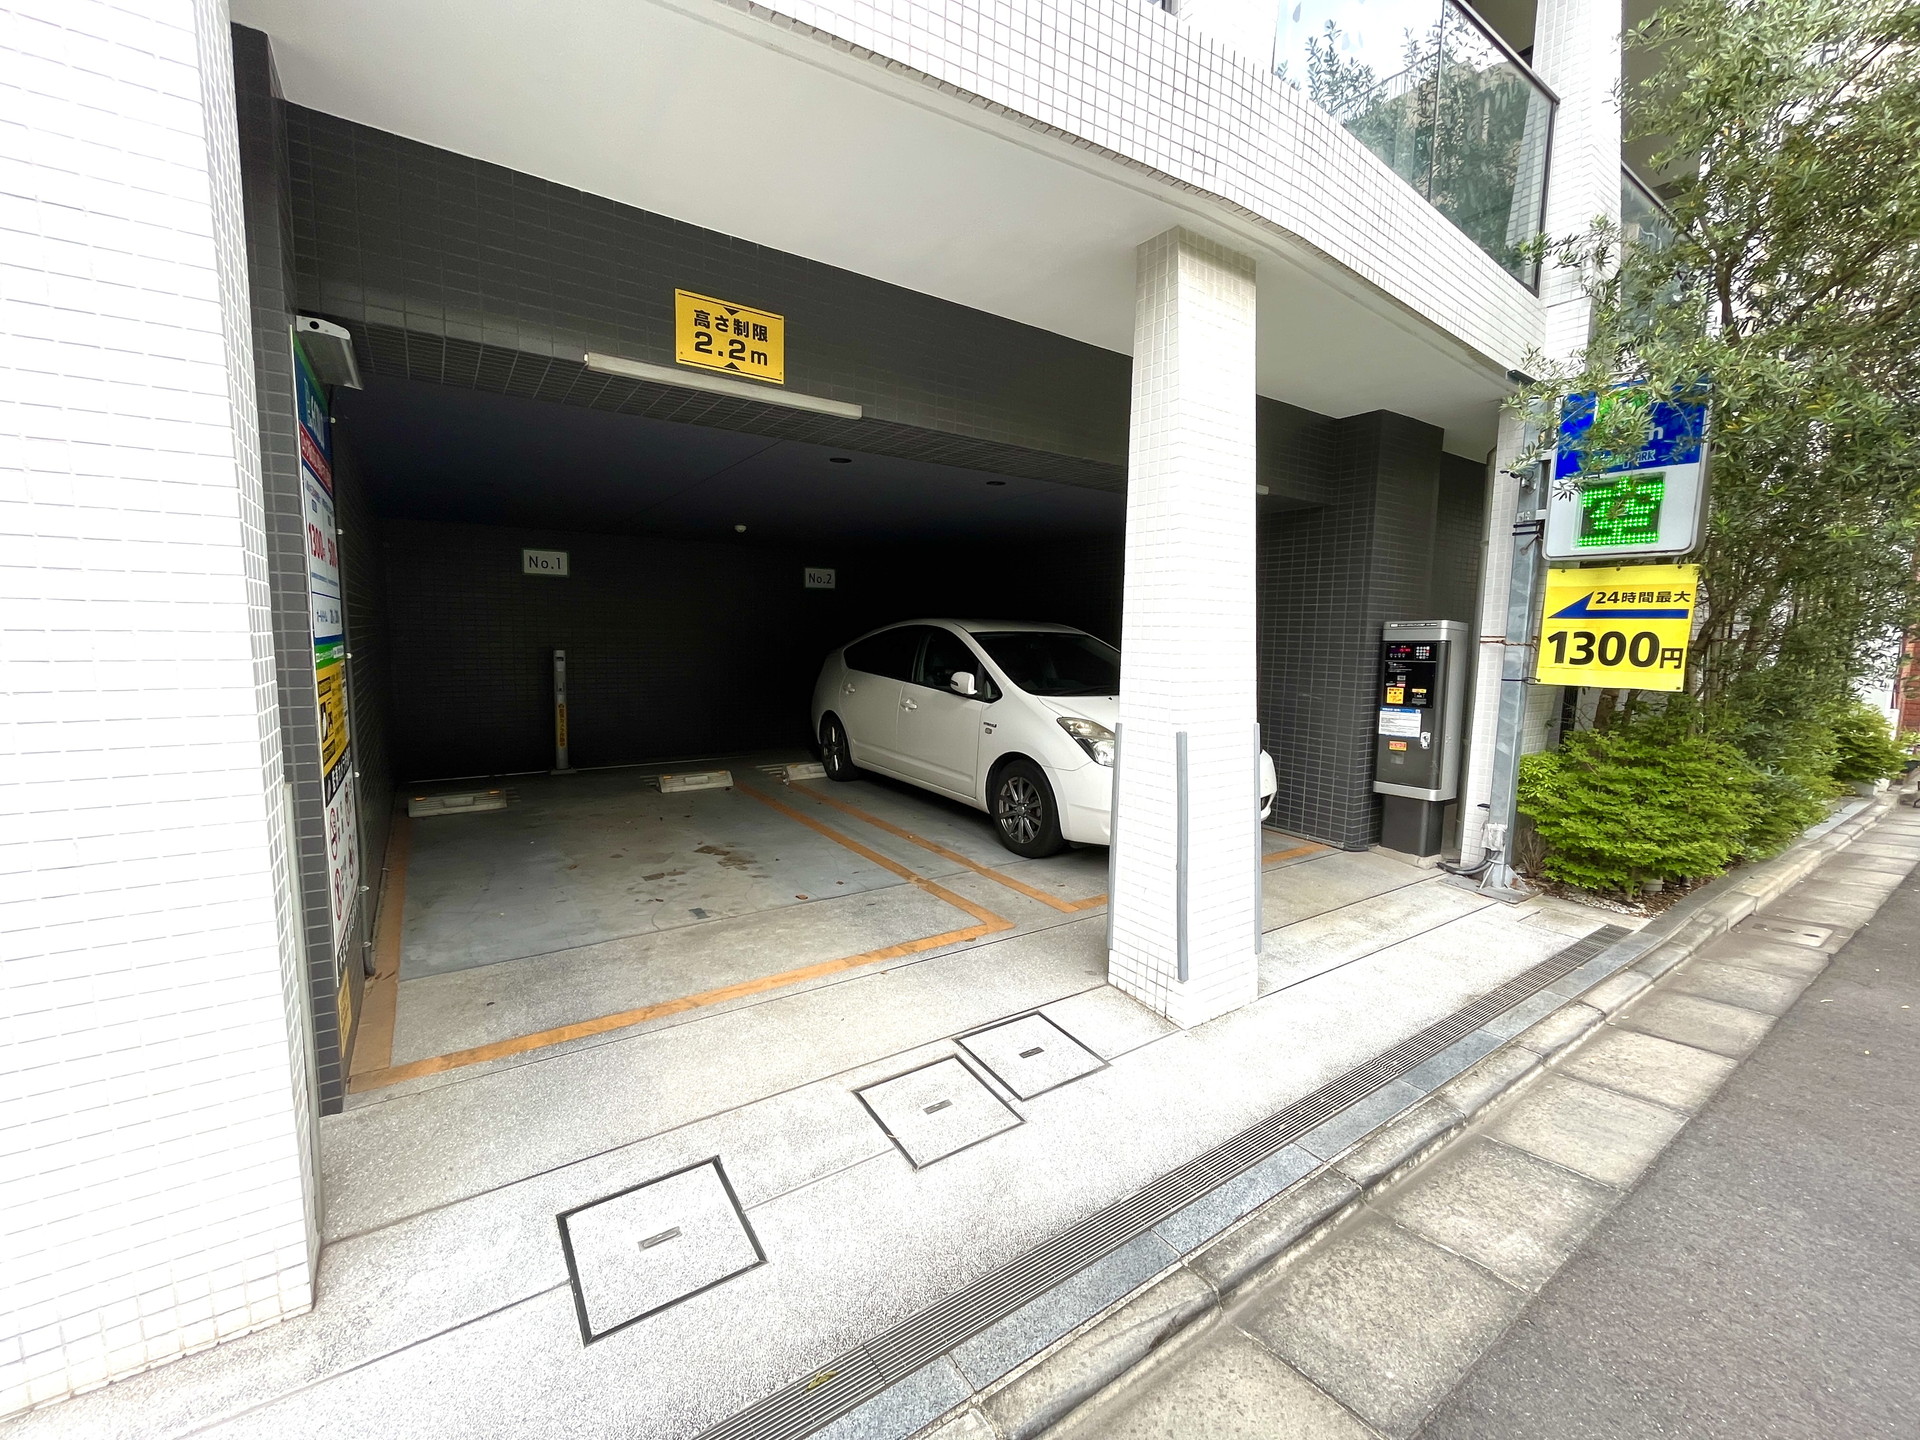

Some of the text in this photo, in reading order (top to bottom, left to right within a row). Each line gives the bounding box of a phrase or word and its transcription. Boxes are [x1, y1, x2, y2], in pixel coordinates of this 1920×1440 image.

[694, 309, 769, 343] 高さ制限
[694, 331, 768, 366] 2.2m
[528, 555, 561, 570] No.1
[809, 572, 832, 585] No.2
[1595, 591, 1691, 604] 24時間最大
[1547, 631, 1684, 669] 1300円
